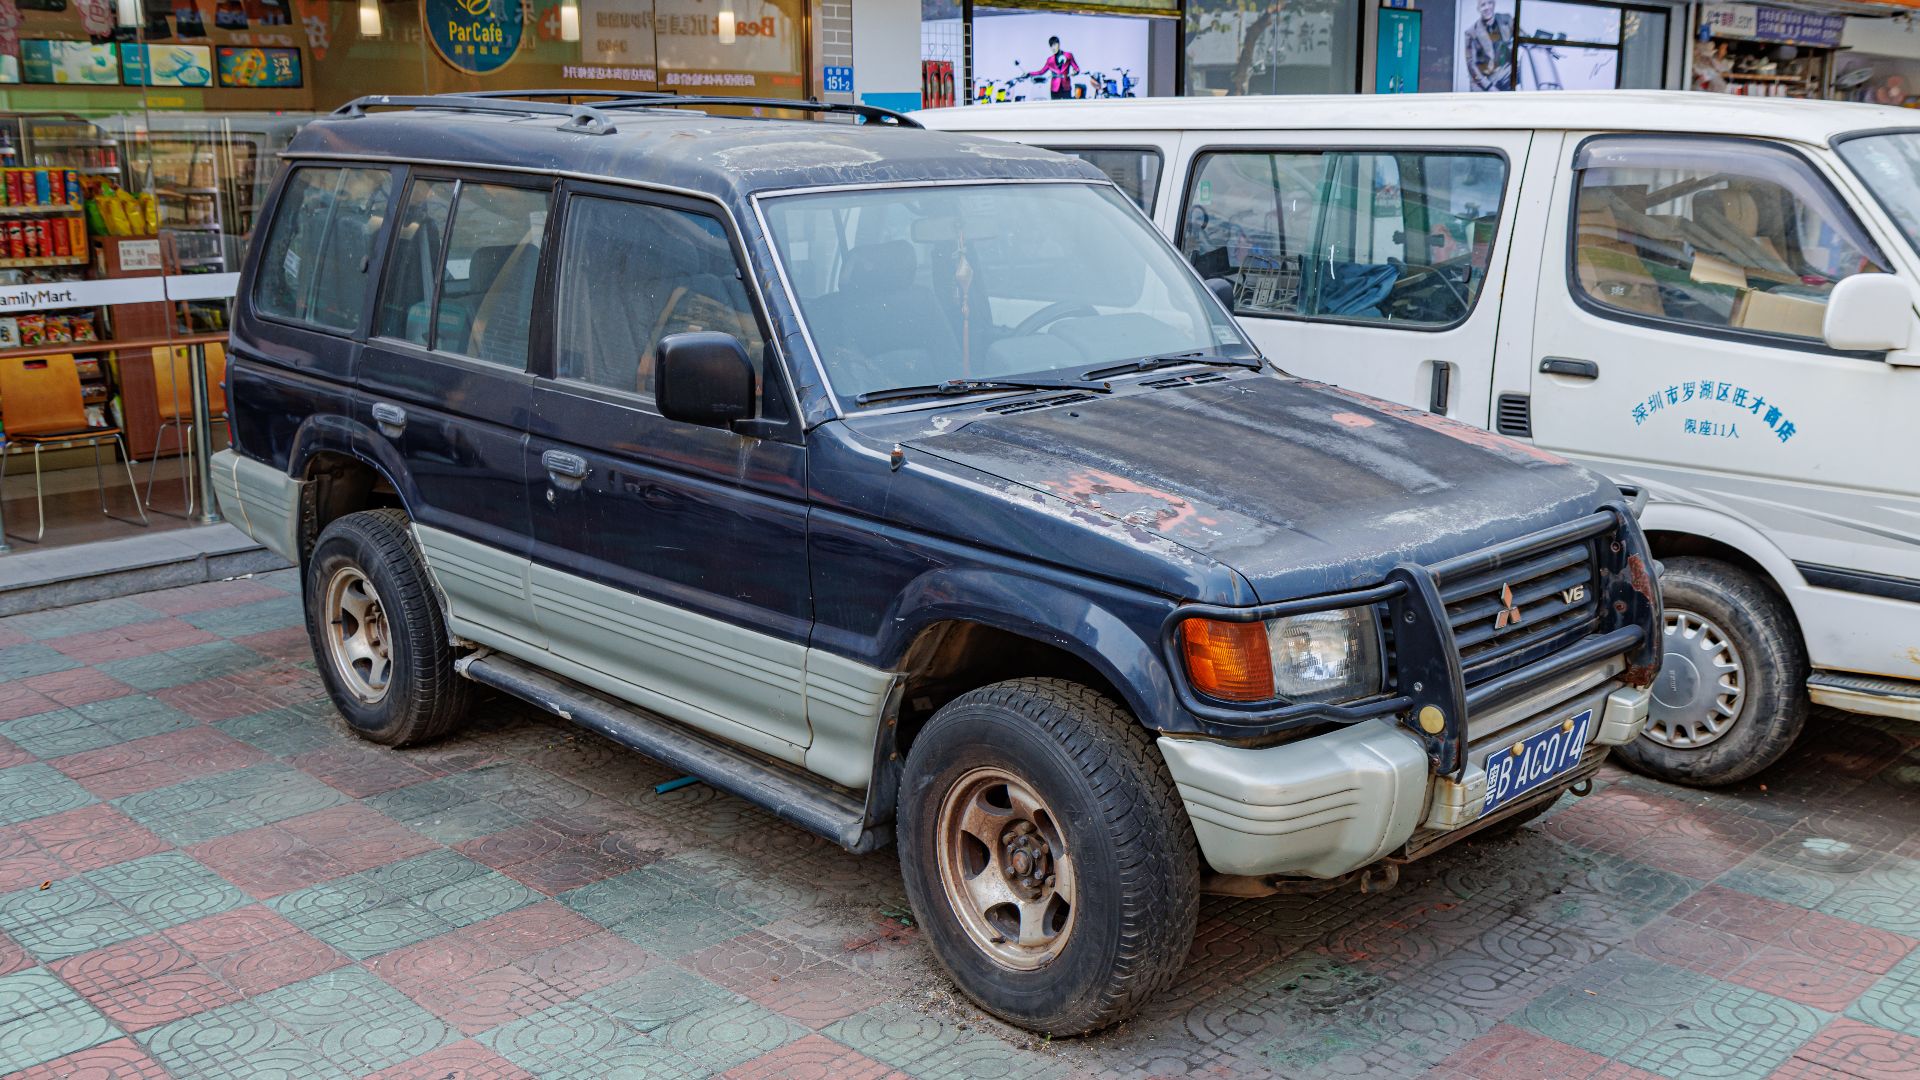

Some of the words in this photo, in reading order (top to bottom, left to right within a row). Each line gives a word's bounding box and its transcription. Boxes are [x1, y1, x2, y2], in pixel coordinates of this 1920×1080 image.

[827, 76, 850, 90] 151-2
[1631, 379, 1797, 443] 深圳市罗湖区旺才商店
[1562, 584, 1585, 604] V6
